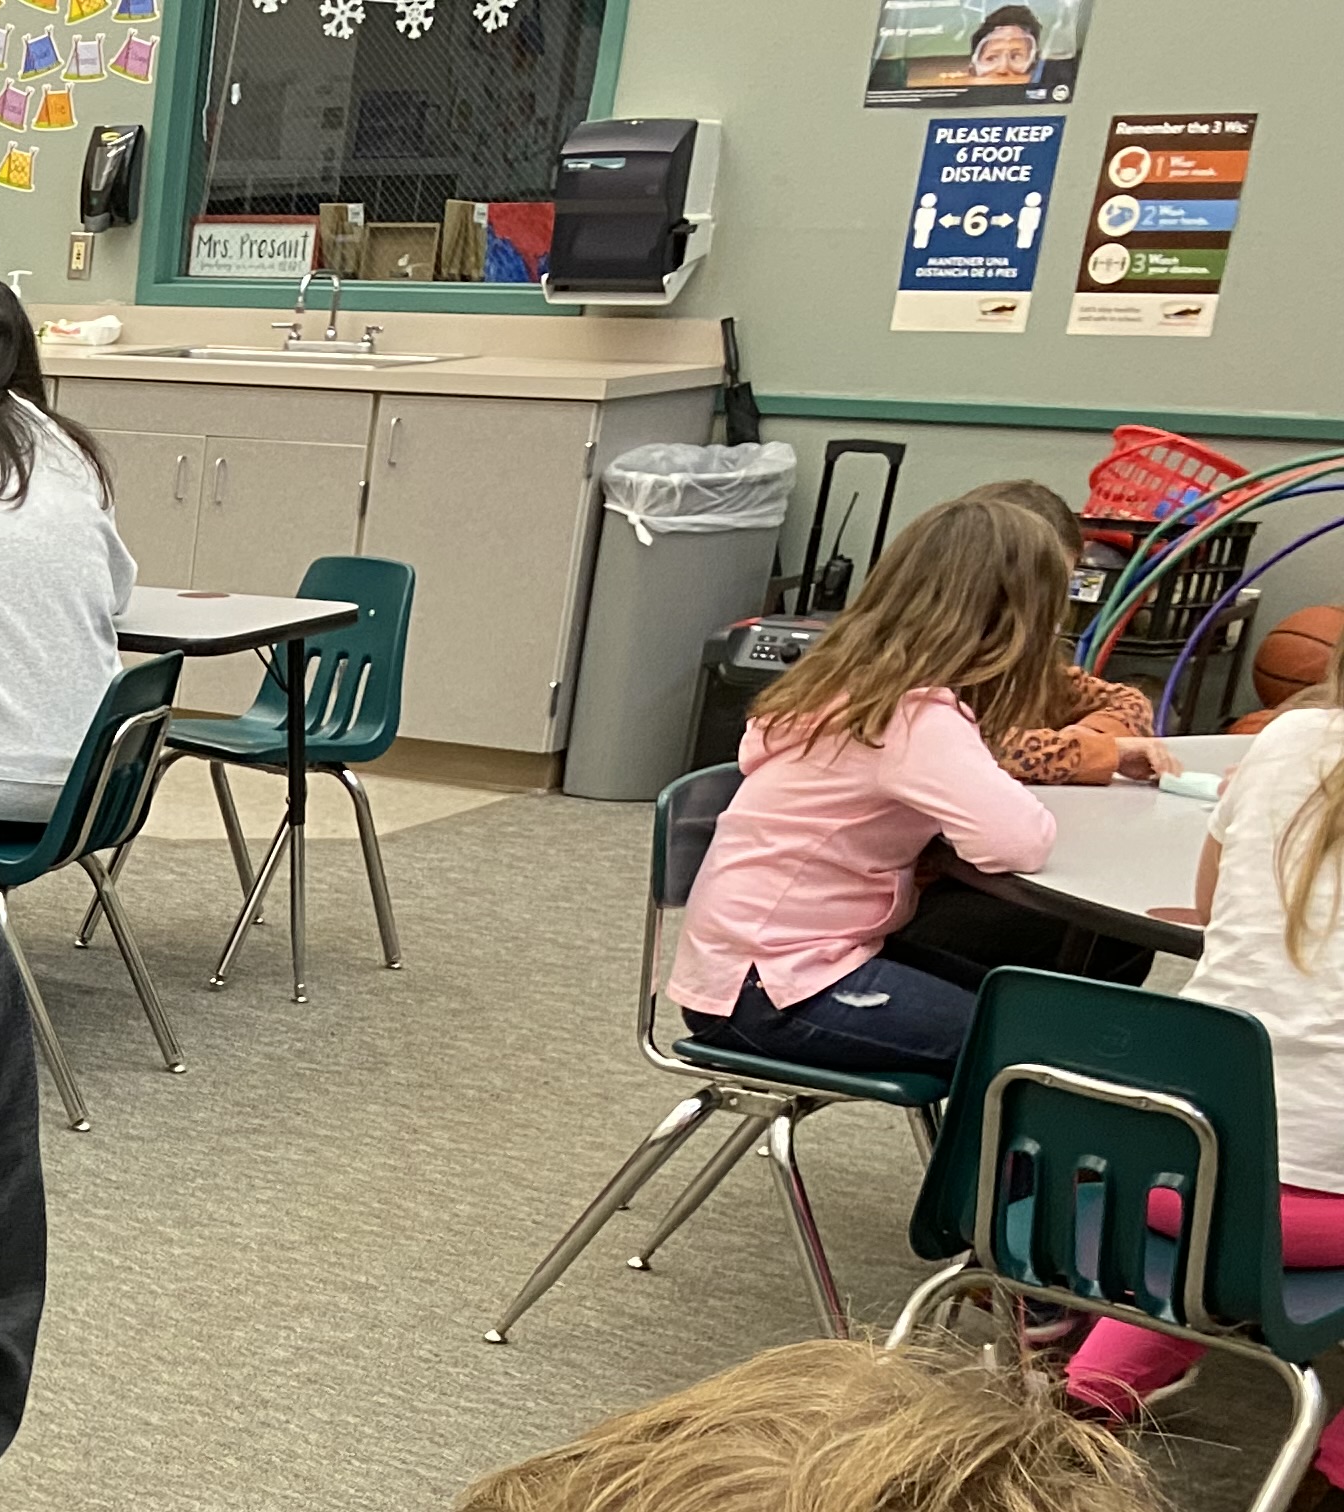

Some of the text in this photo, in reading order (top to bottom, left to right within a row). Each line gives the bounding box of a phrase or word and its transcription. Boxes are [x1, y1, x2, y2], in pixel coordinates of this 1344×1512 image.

[935, 126, 1054, 143] PLEASE KEEP
[1116, 121, 1185, 134] Remember
[1187, 121, 1210, 133] the
[1212, 121, 1222, 134] 3
[956, 146, 1024, 163] 6 FOOT
[941, 165, 1032, 183] DISTANCE
[963, 204, 990, 236] 6
[1142, 205, 1158, 225] 2
[196, 231, 310, 261] Mrs. Presant
[927, 257, 1009, 266] MANTENER UNA
[1132, 253, 1147, 273] 3
[915, 268, 969, 278] DISTANCIA
[971, 268, 985, 277] DE
[995, 268, 1017, 277] PIES
